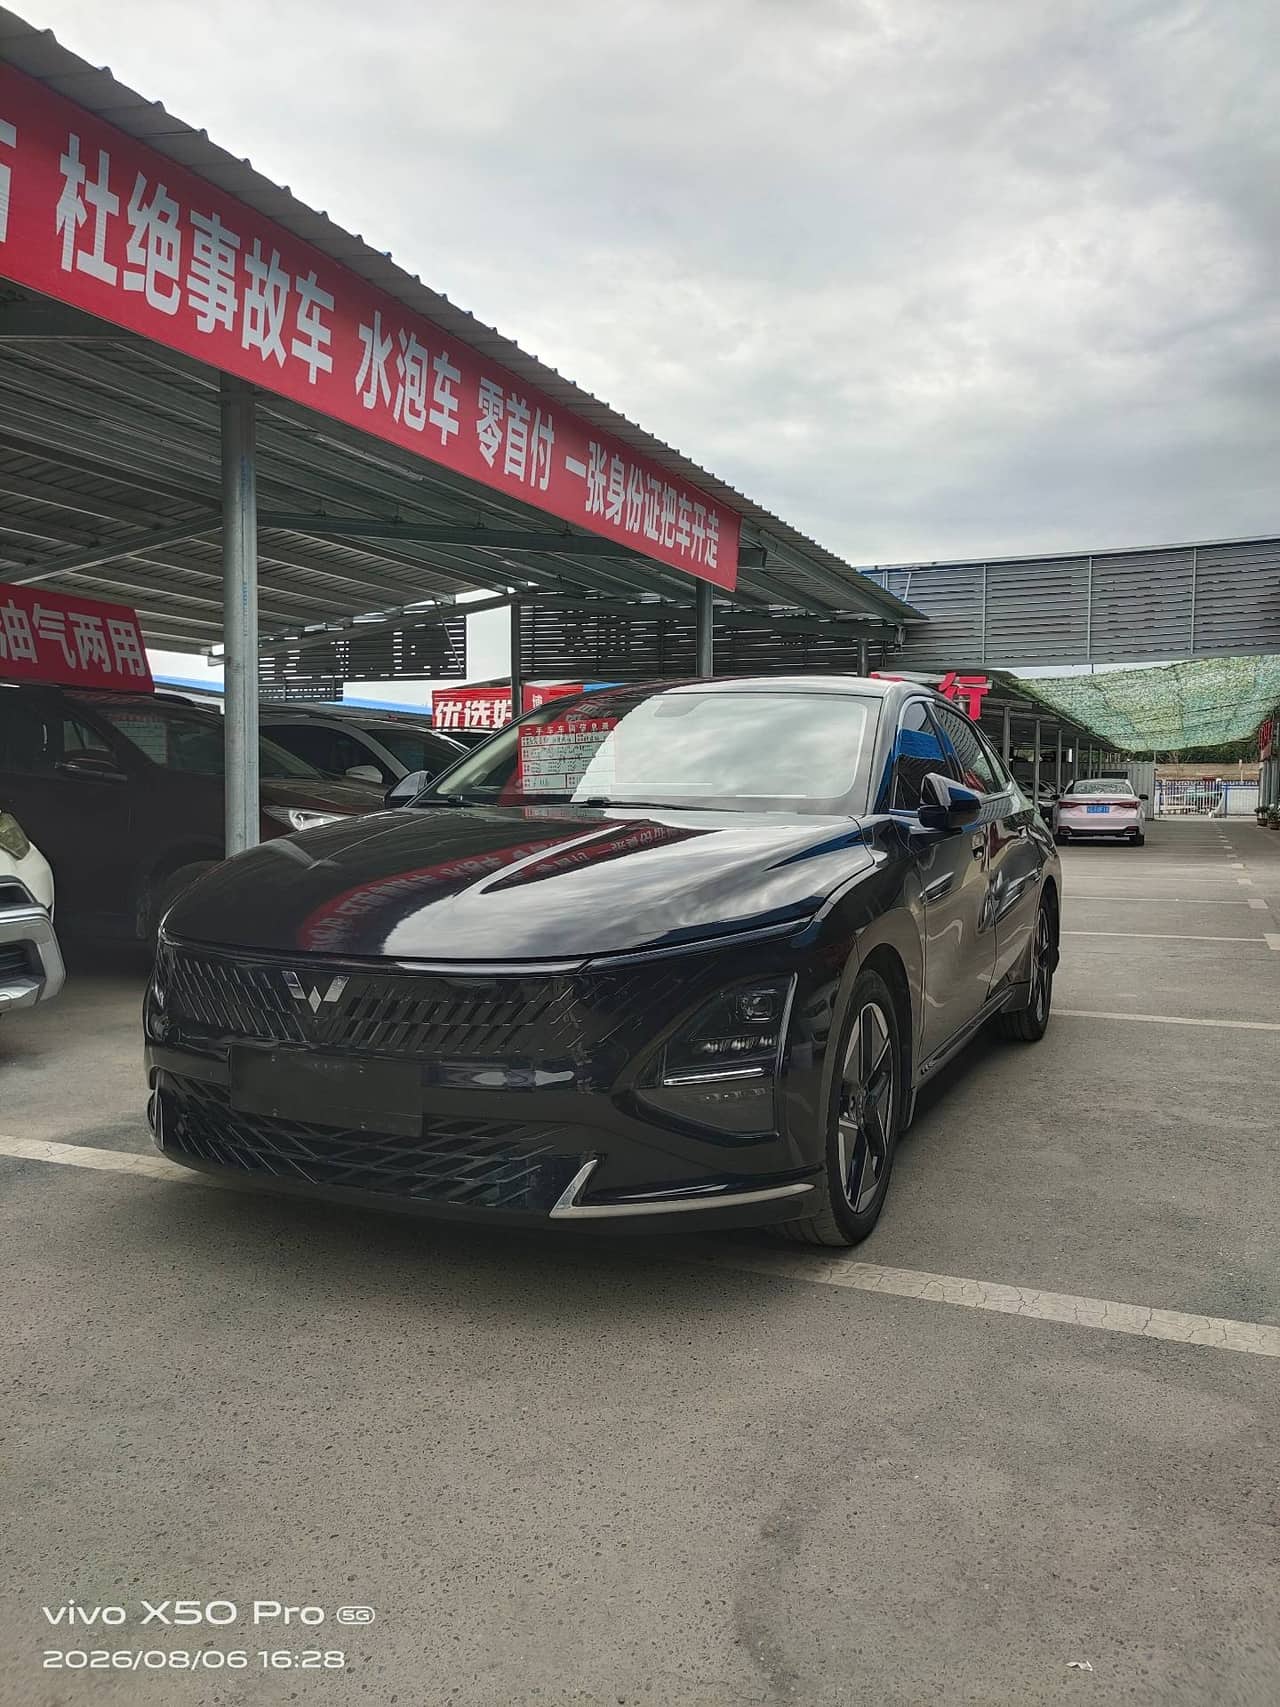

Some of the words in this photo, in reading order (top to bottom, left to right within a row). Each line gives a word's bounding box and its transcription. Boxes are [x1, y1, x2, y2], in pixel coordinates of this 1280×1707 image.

[56, 132, 334, 385] 杜绝事故车
[355, 310, 461, 446] 水泡车
[476, 376, 555, 490] 零首付
[565, 440, 719, 568] 一张身份证把车开走
[0, 599, 146, 676] 油气两用
